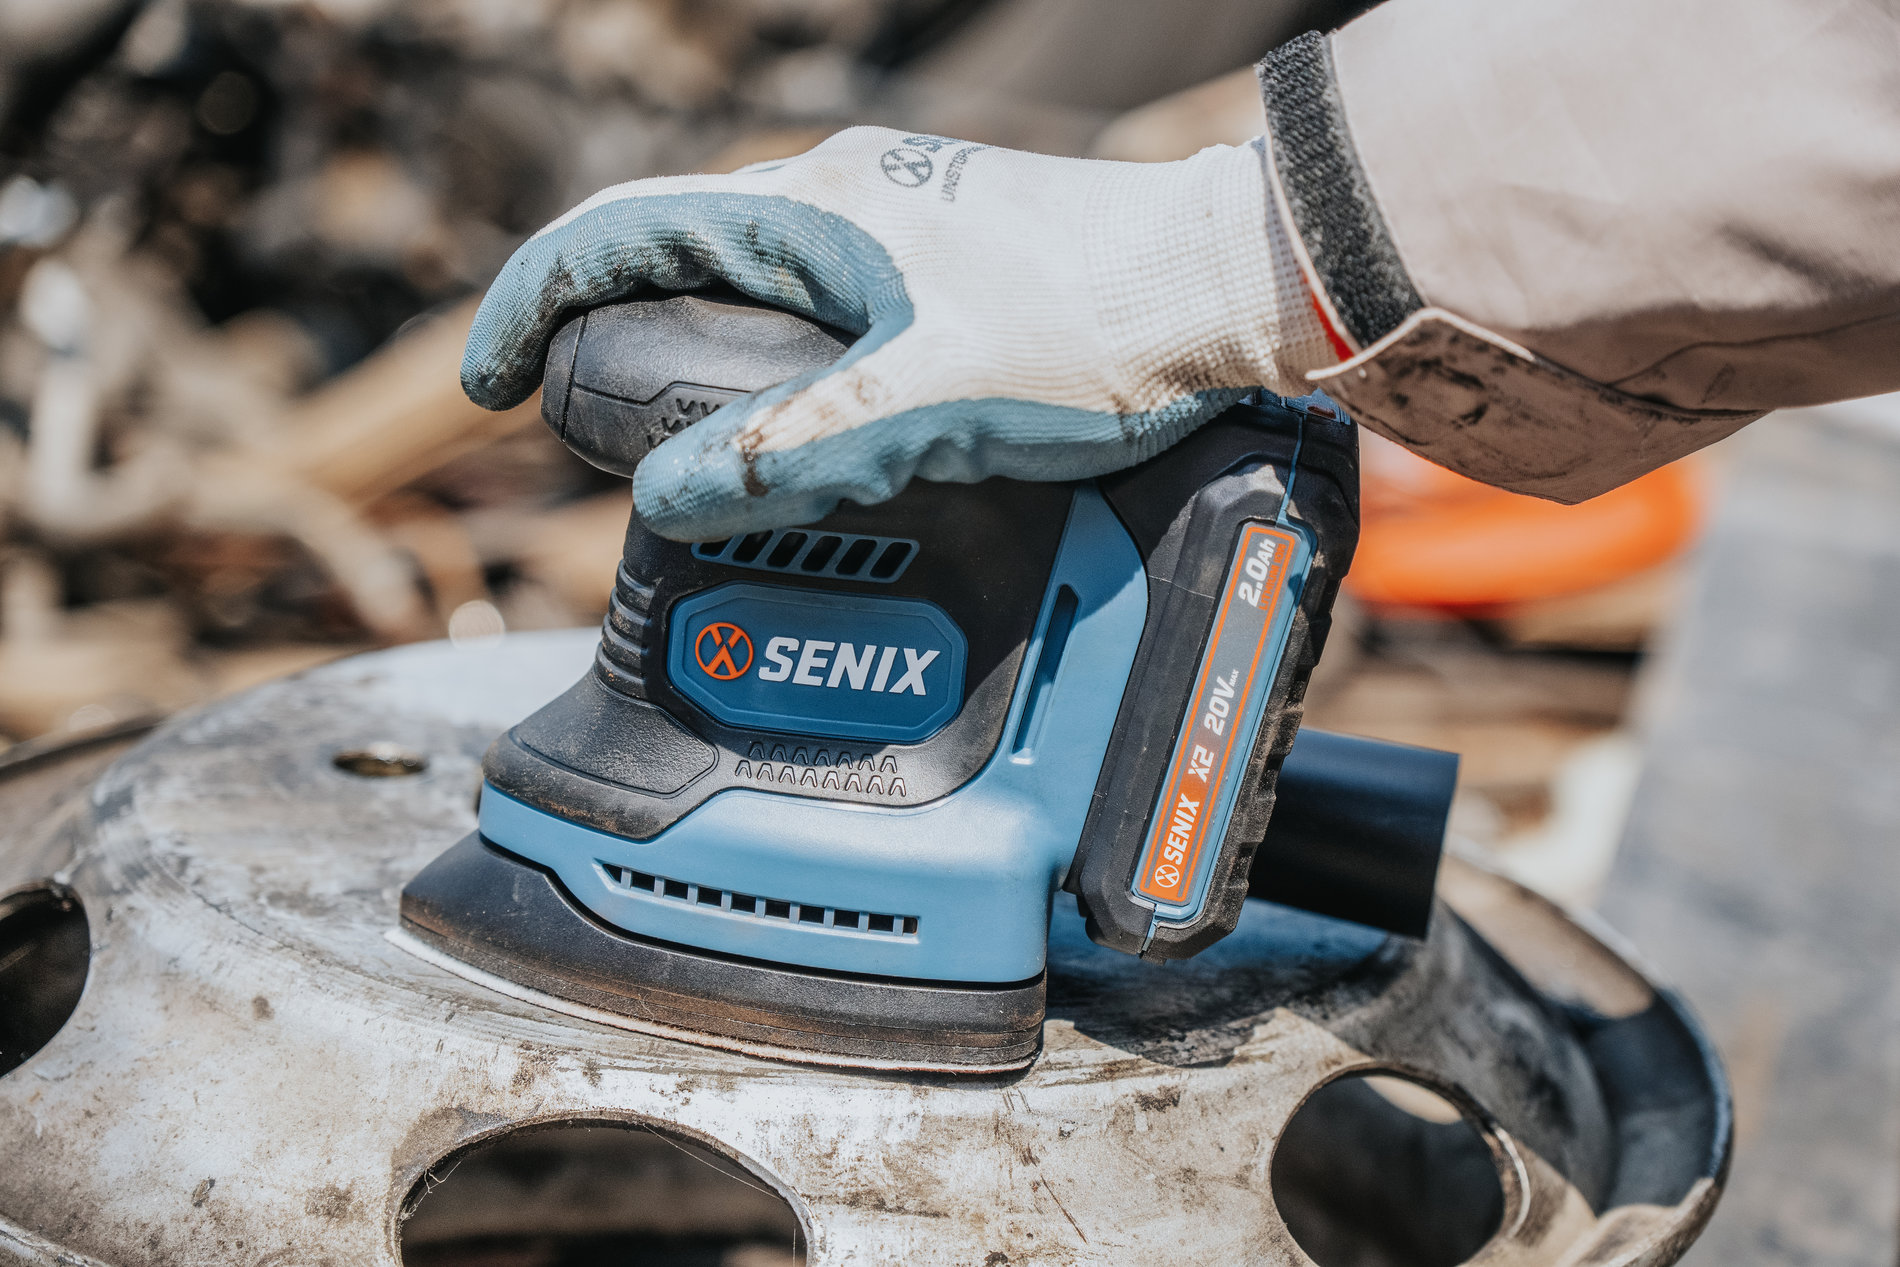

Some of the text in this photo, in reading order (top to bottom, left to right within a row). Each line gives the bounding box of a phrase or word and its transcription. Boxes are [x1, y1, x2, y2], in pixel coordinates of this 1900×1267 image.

[1238, 539, 1276, 607] 2.0Ah
[1259, 543, 1287, 610] LITHIUM ION
[758, 636, 941, 696] SENIX
[1163, 793, 1200, 865] SENIX
[1188, 744, 1214, 783] X2
